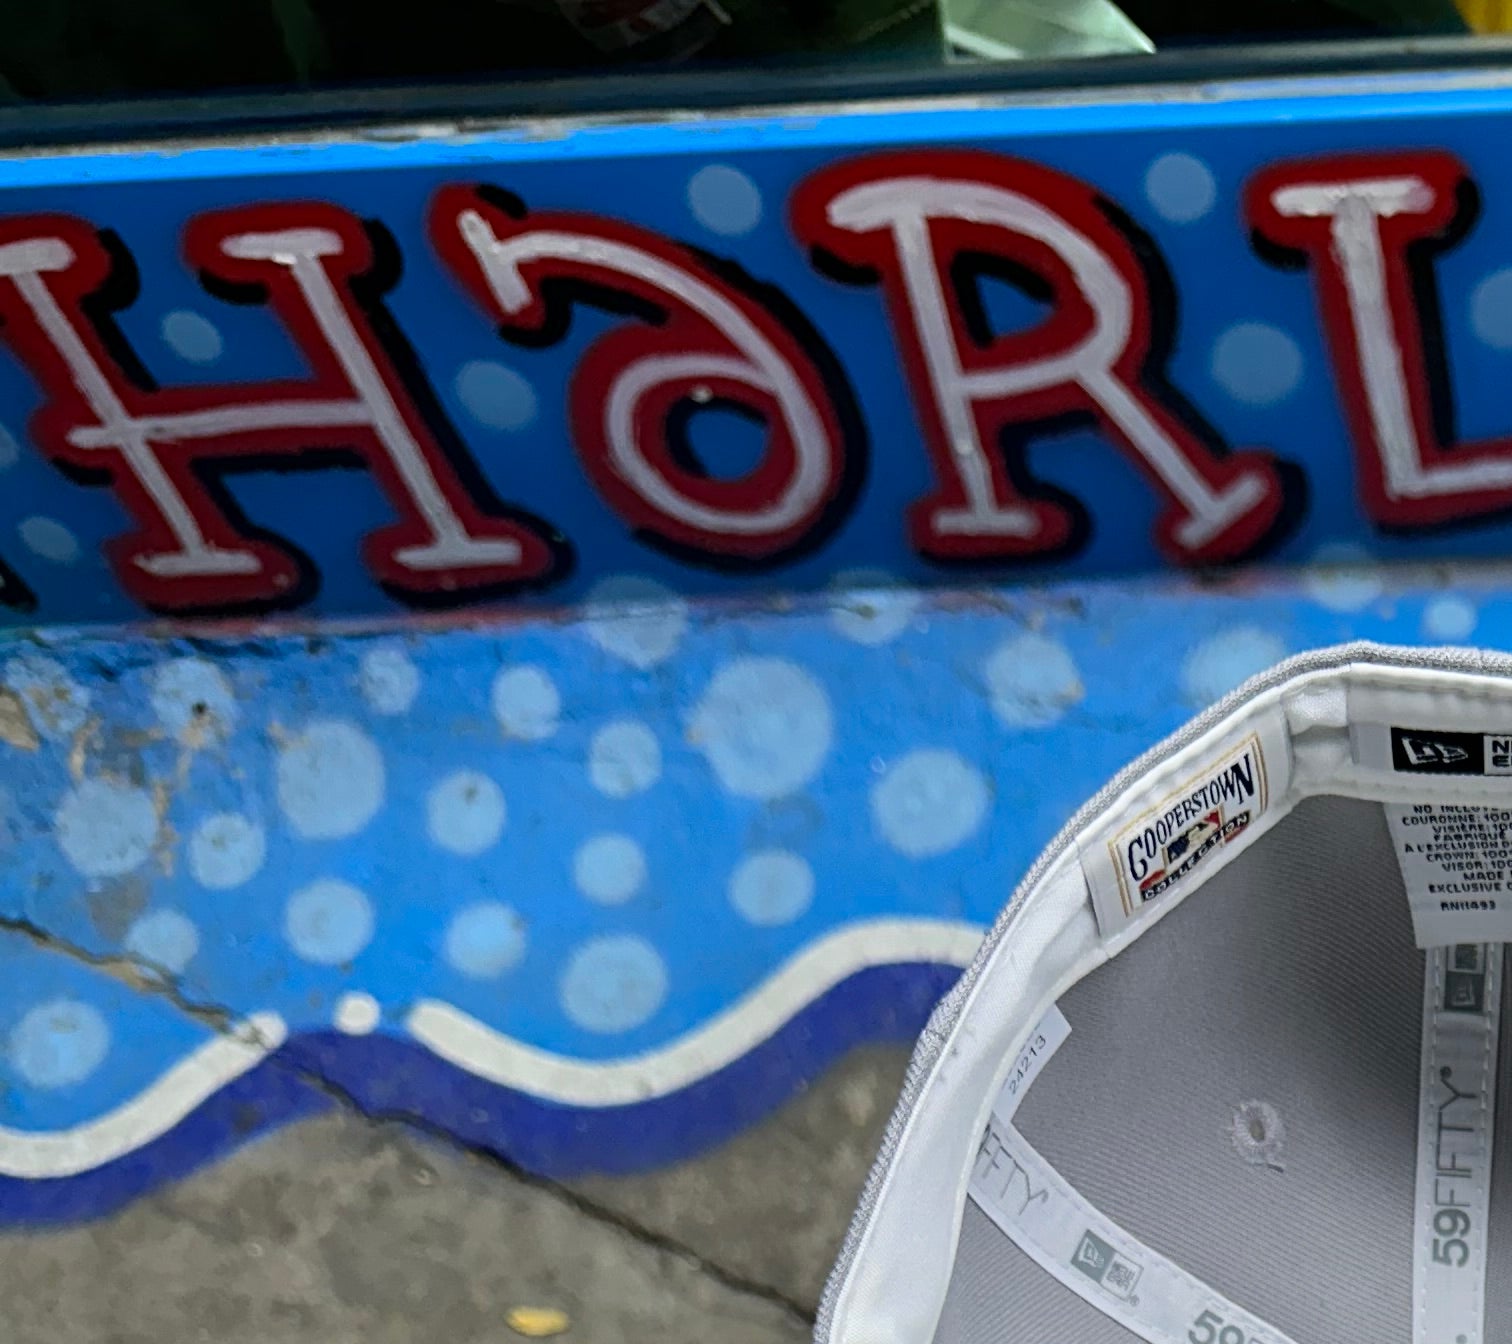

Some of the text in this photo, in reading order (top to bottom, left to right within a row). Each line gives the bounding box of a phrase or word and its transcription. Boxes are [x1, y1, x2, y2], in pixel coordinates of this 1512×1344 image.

[1127, 752, 1256, 882] COOPERSTOWN
[1427, 882, 1503, 894] EXCLUSIVE
[1462, 870, 1505, 882] MADE
[1432, 1075, 1480, 1268] 59FIFTY
